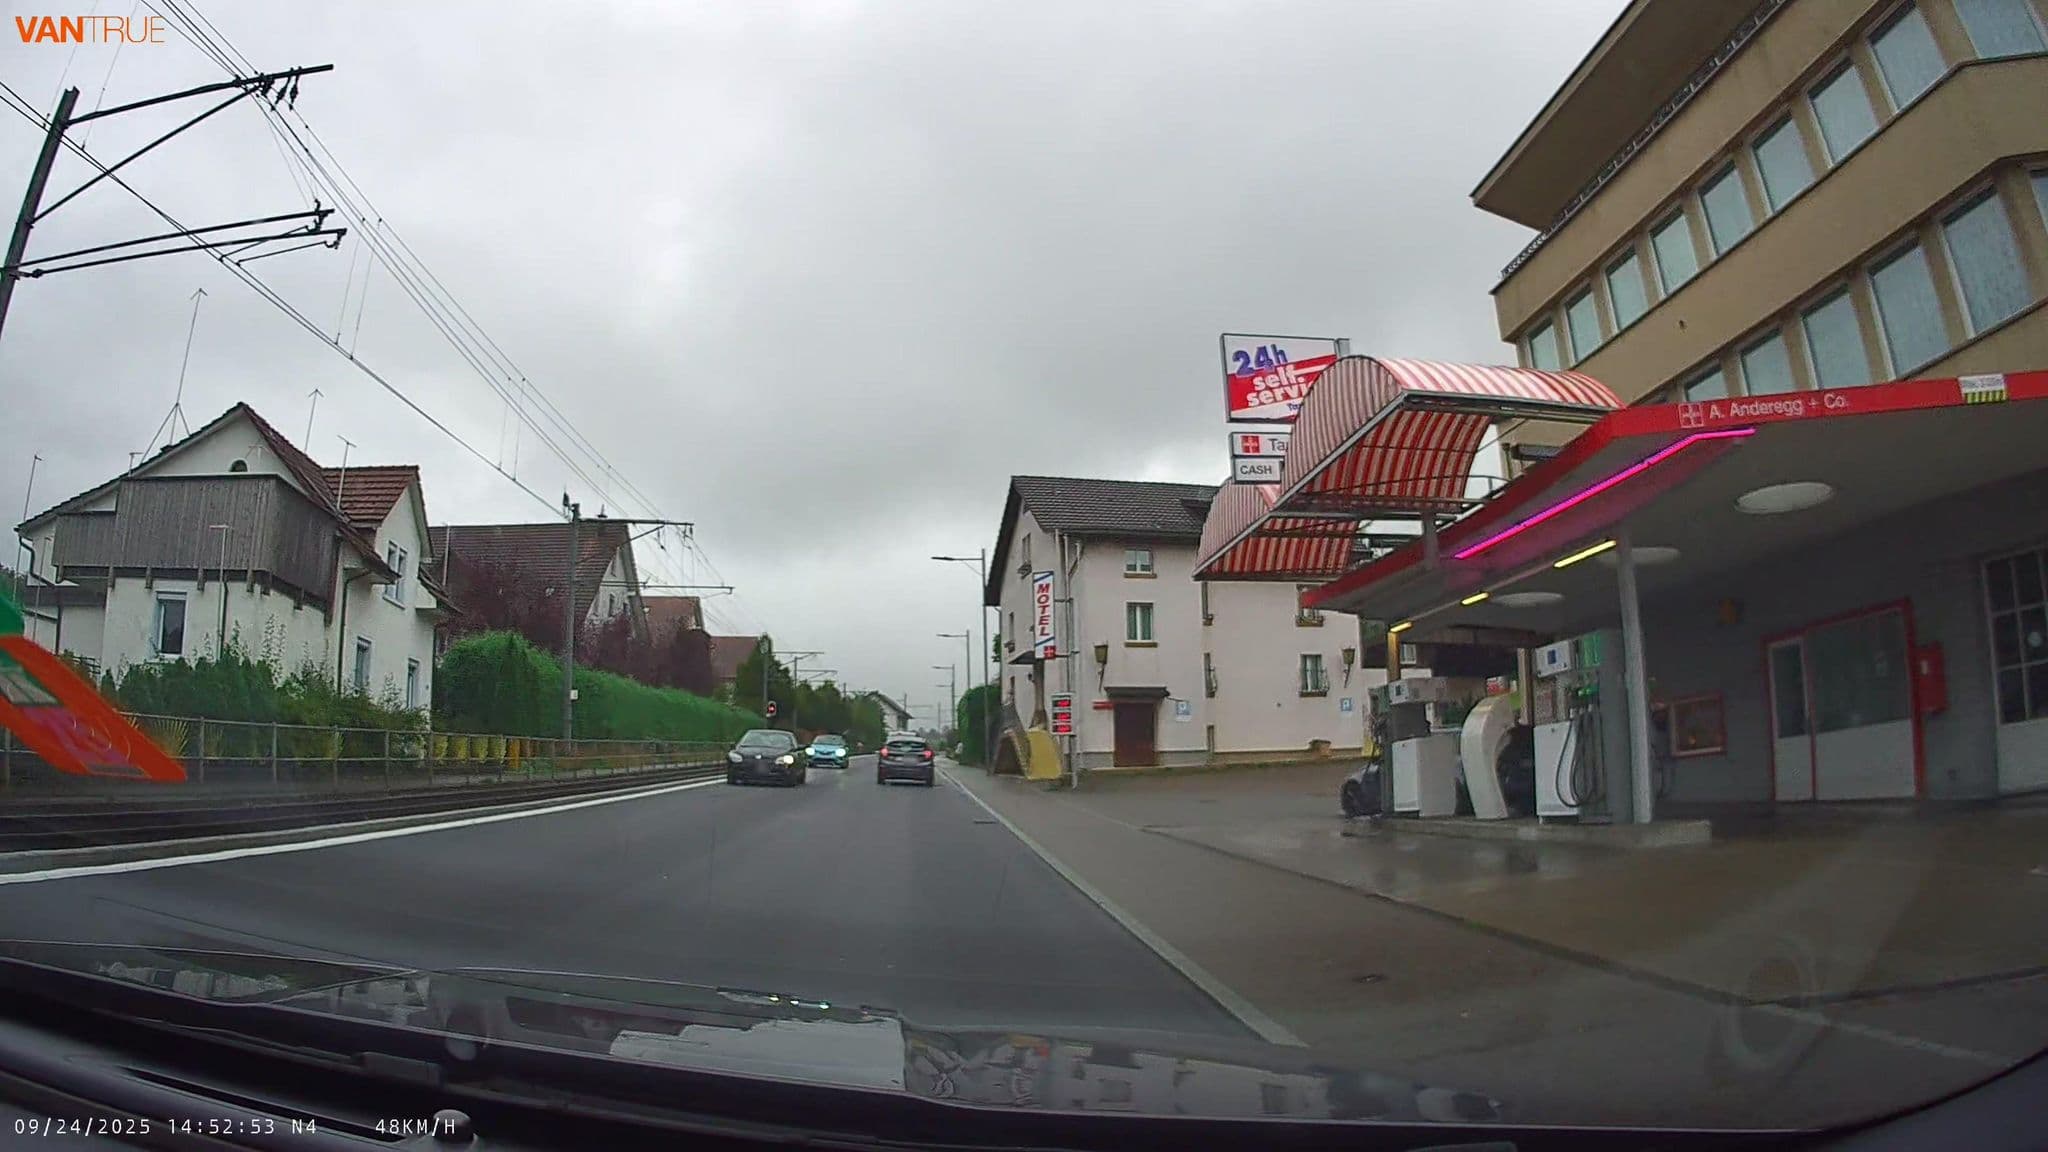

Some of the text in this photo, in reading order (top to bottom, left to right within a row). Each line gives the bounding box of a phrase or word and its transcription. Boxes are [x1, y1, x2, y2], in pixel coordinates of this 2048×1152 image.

[1232, 344, 1287, 377] 24h
[1709, 406, 1724, 419] A.
[1730, 399, 1803, 416] Anderegg
[1240, 464, 1272, 476] CASH
[1037, 583, 1050, 636] MOTEL
